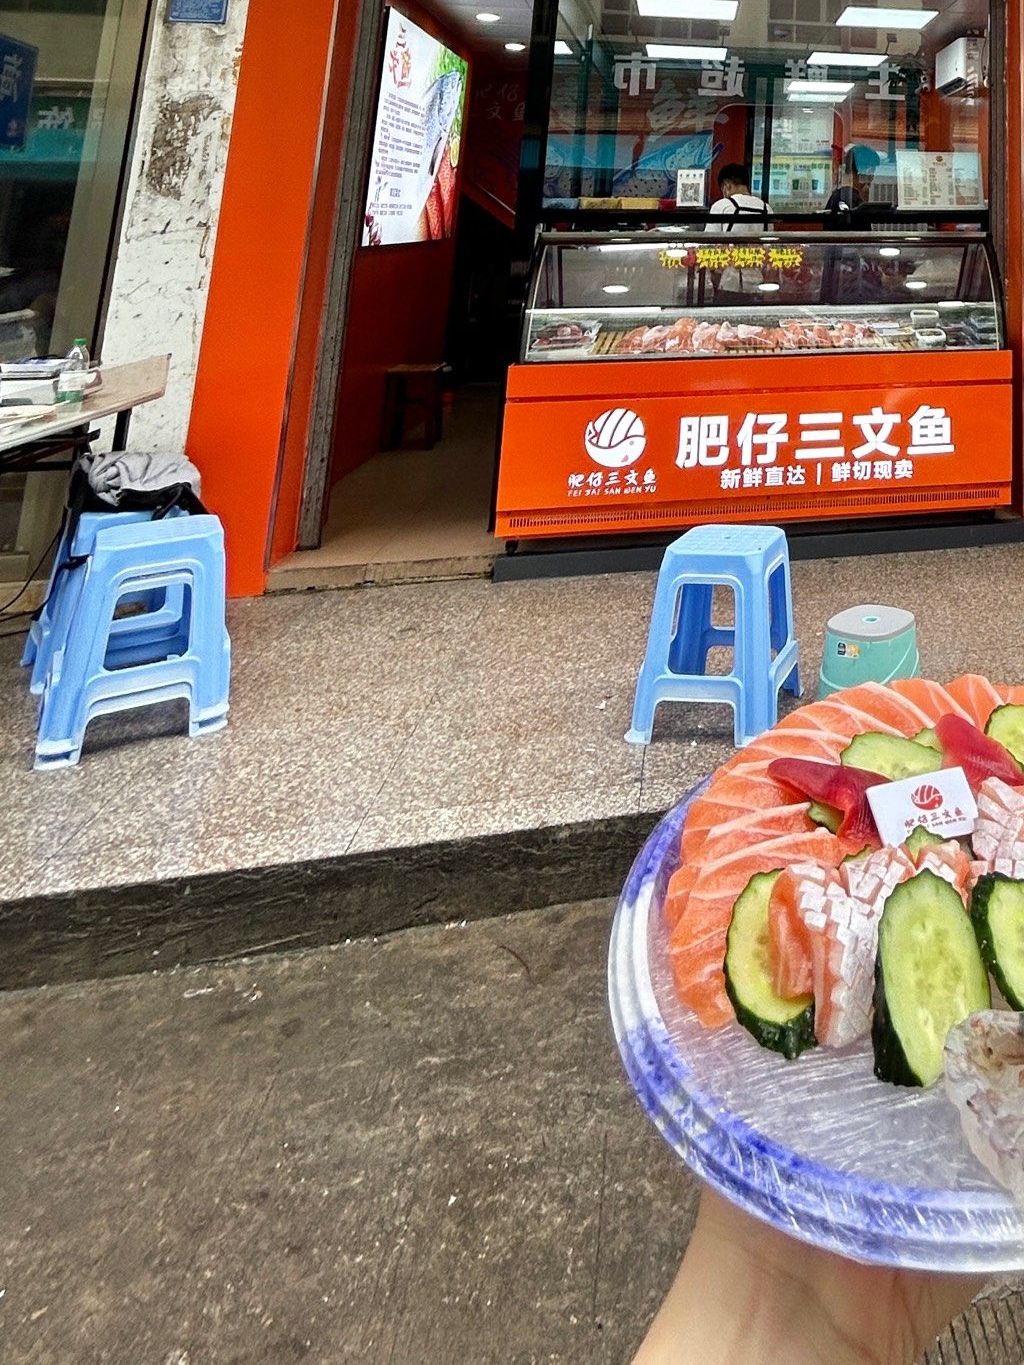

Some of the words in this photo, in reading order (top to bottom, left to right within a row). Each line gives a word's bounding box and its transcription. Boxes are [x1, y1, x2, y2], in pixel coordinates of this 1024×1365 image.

[675, 405, 955, 469] 肥仔三文鱼
[568, 468, 656, 489] 肥仔三文鱼
[720, 465, 807, 490] 新鲜直达
[832, 459, 914, 483] 鲜切现卖
[644, 485, 657, 493] YU
